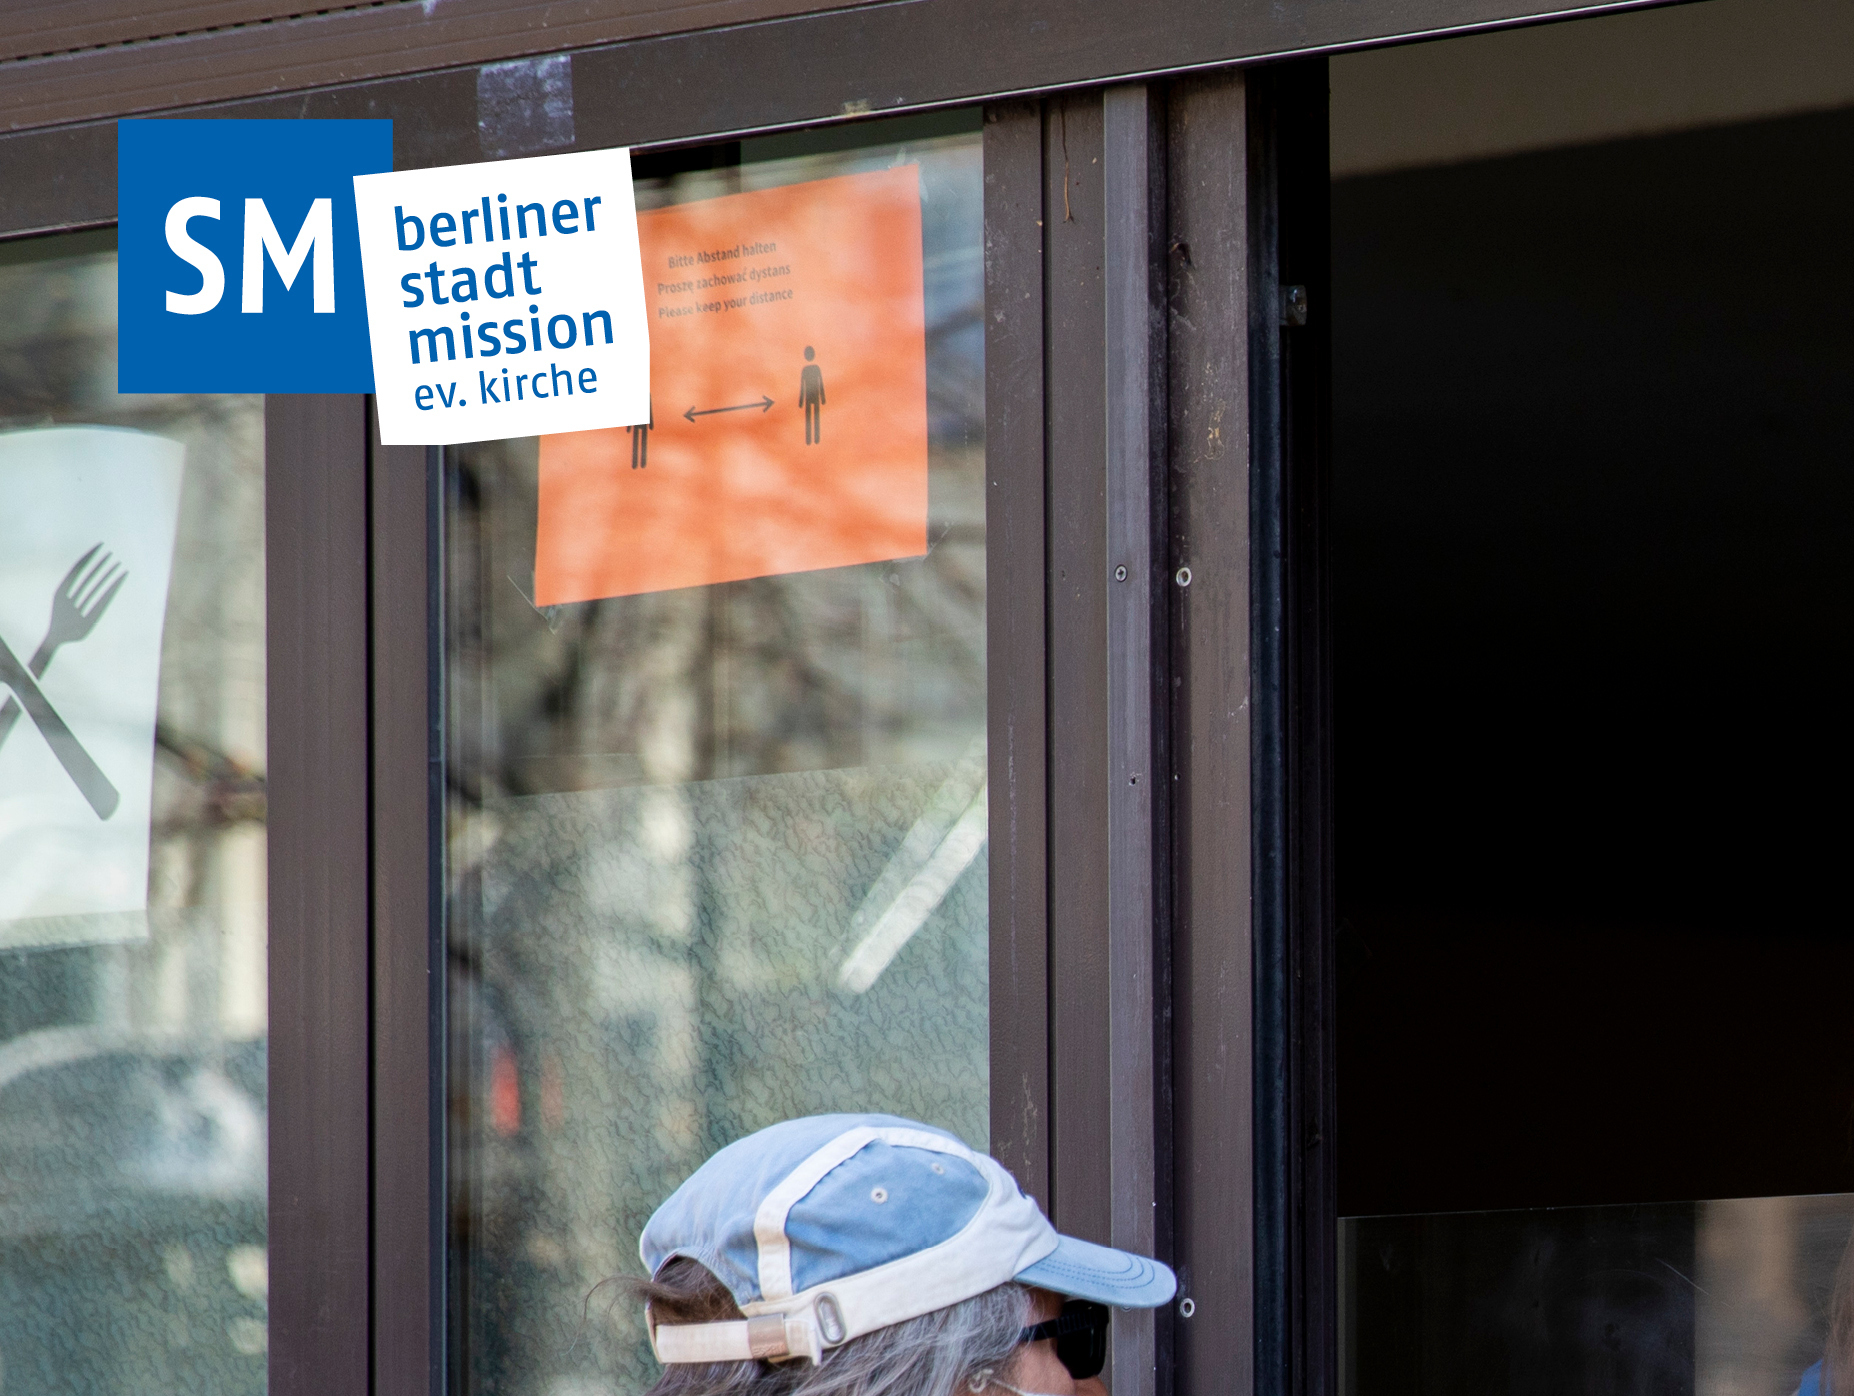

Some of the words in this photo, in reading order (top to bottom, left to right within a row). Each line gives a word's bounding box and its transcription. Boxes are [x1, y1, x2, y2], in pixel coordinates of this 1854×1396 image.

[668, 255, 694, 269] Bitte
[697, 245, 740, 264] Abstand
[742, 242, 777, 257] halten
[657, 280, 694, 295] Proszę
[697, 267, 748, 289] zachować
[750, 264, 791, 283] dystans
[658, 304, 694, 319] Please
[696, 300, 722, 313] keep
[723, 296, 747, 312] your
[750, 288, 794, 305] distance
